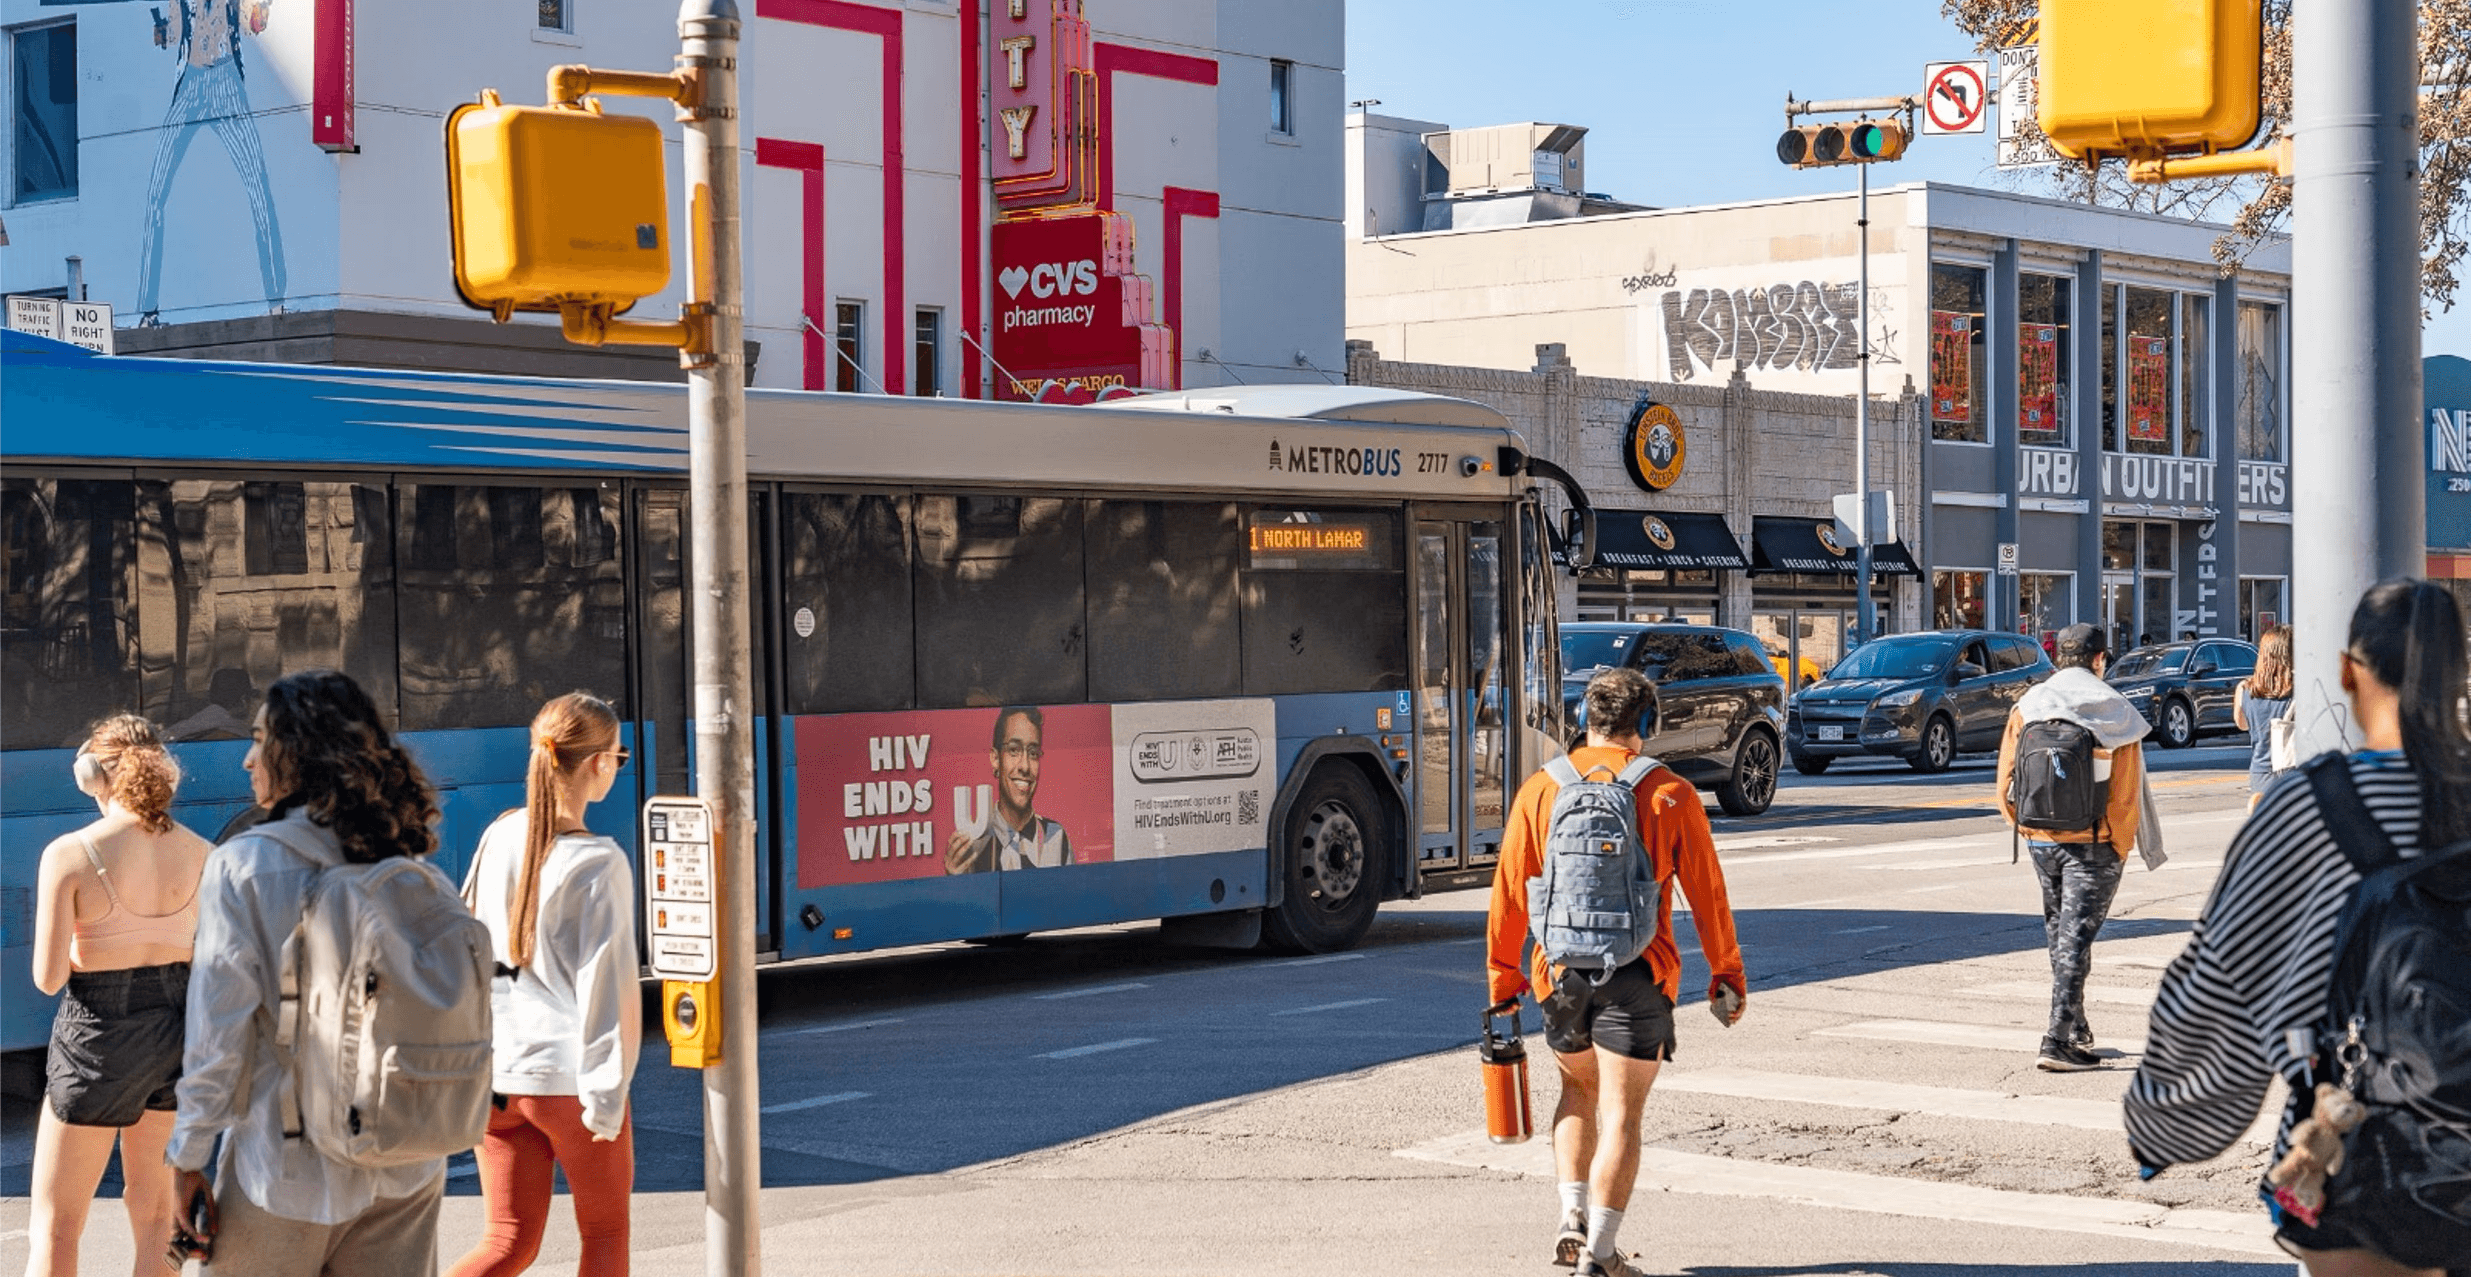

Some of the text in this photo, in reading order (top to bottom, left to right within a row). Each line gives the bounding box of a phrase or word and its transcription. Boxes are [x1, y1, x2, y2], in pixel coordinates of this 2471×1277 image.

[1030, 258, 1098, 298] CVS
[16, 301, 52, 312] TURNING
[76, 308, 98, 323] NO
[18, 314, 50, 325] TRAFFIC
[1003, 304, 1095, 333] pharmacy
[71, 326, 104, 339] RIGHT
[1010, 377, 1066, 395] WELS
[1288, 447, 1401, 476] METROBUS
[1418, 453, 1449, 473] 2717
[2121, 457, 2286, 505] OUTFITERS
[1250, 527, 1364, 550] 1 NORTH LAMAR
[1602, 552, 1744, 567] BREAKFAST LUNCH CATERING
[1781, 558, 1830, 570] BREAKFAST
[869, 734, 931, 772] HIV
[1139, 751, 1159, 761] ENDS
[1140, 760, 1159, 769] WITH
[843, 779, 933, 818] ENDS
[1134, 795, 1232, 810] Find treatment options at
[953, 784, 993, 840] U
[1134, 810, 1231, 829] HIVEndsWithU.org
[843, 821, 934, 861] WITH
